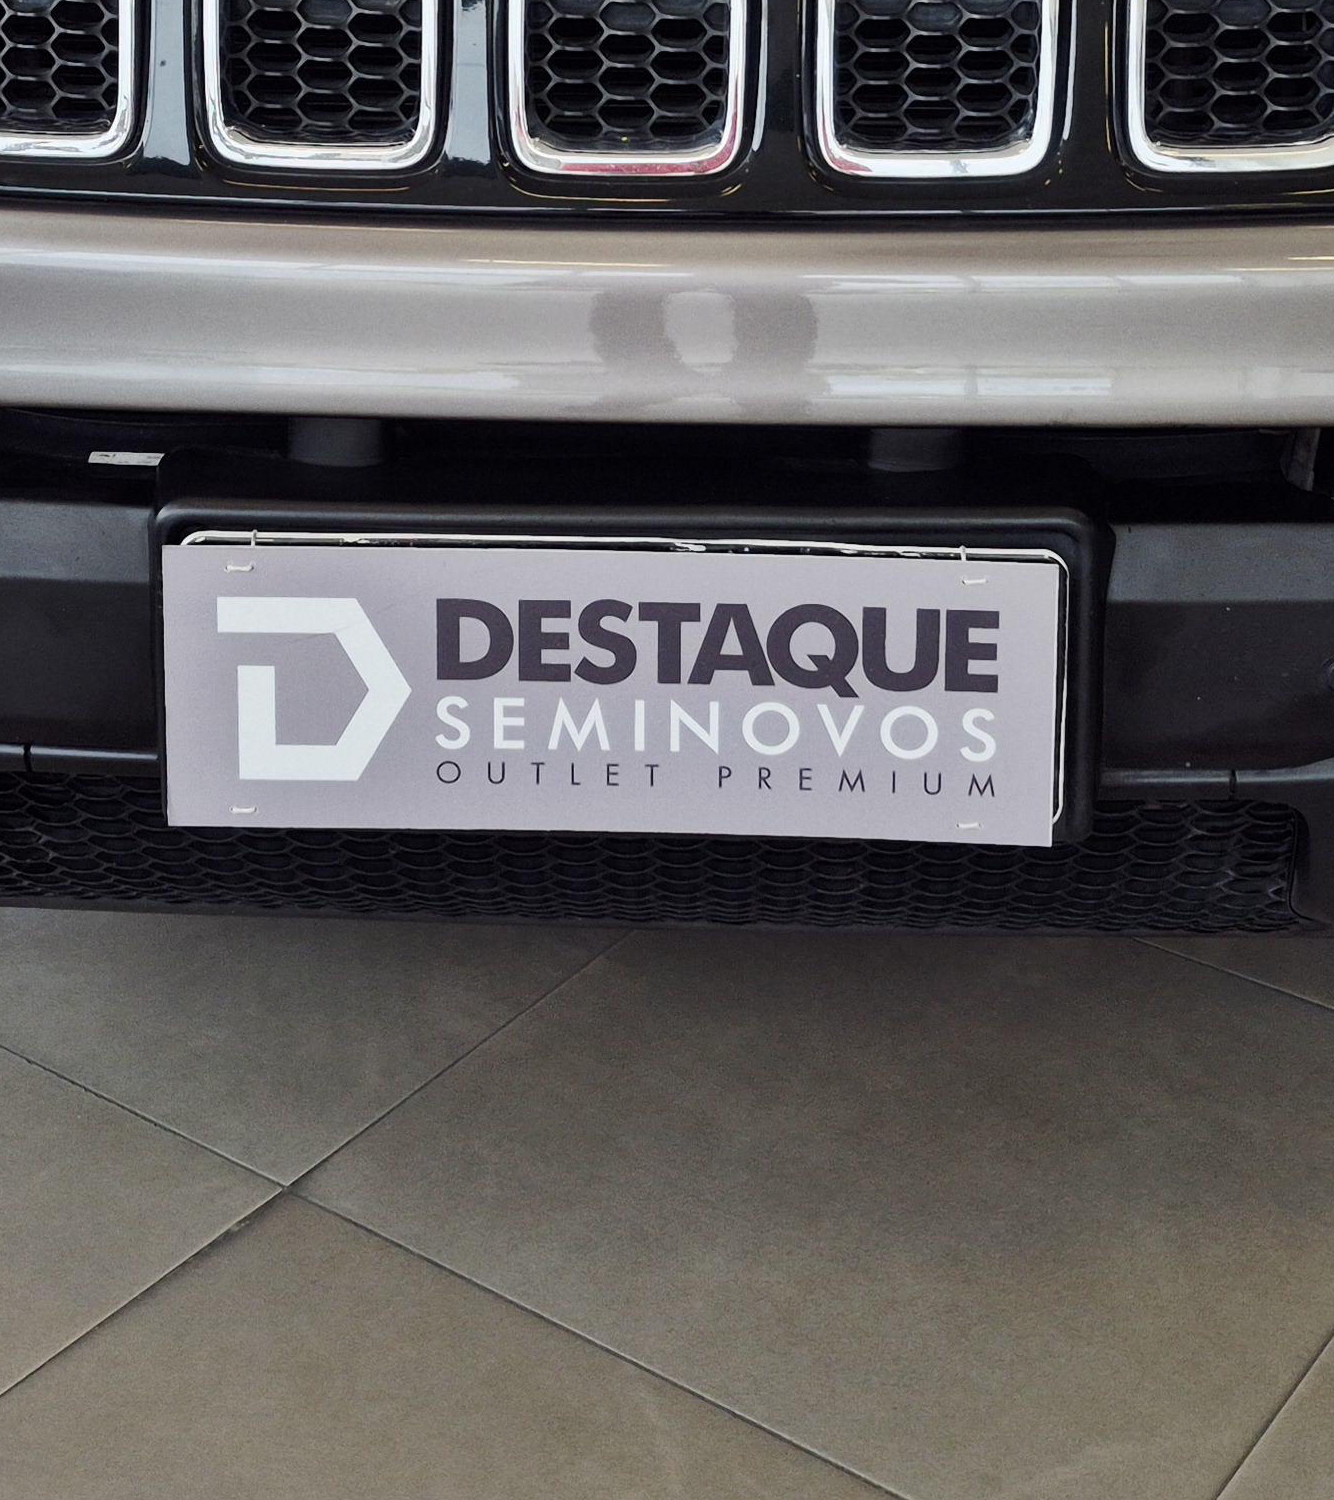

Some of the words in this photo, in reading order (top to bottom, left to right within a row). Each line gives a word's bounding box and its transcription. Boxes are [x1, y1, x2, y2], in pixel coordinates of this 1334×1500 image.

[435, 597, 1000, 698] DESTAQUE
[434, 695, 997, 763] SEMINOVOS
[435, 759, 661, 788] OUTLET
[717, 765, 997, 798] PREMIUM
